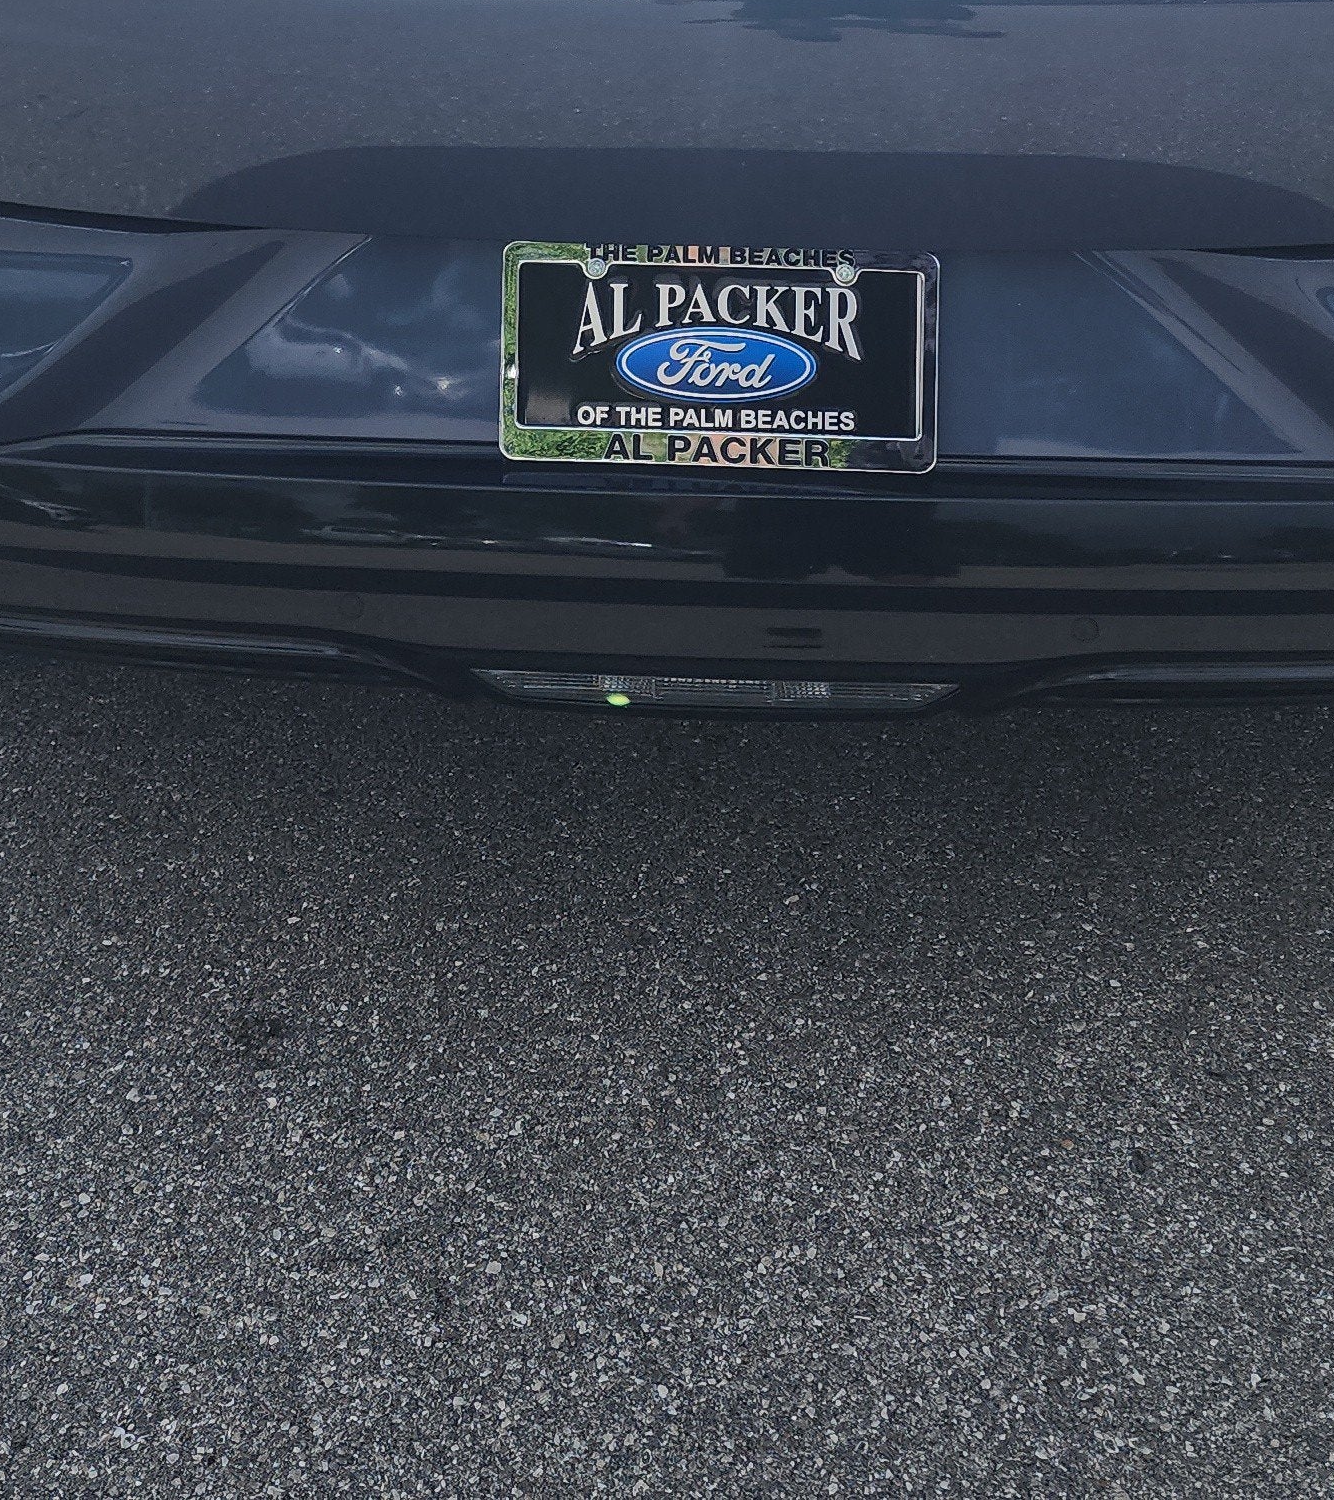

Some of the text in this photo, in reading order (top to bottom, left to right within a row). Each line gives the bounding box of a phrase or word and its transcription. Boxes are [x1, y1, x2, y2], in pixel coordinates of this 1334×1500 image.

[583, 243, 855, 267] THE PALM BEACHES
[572, 281, 863, 361] AL PACKER
[656, 338, 773, 389] Ford
[577, 405, 856, 432] OF THE PALM BEACHES
[603, 432, 830, 468] AL PACKER
